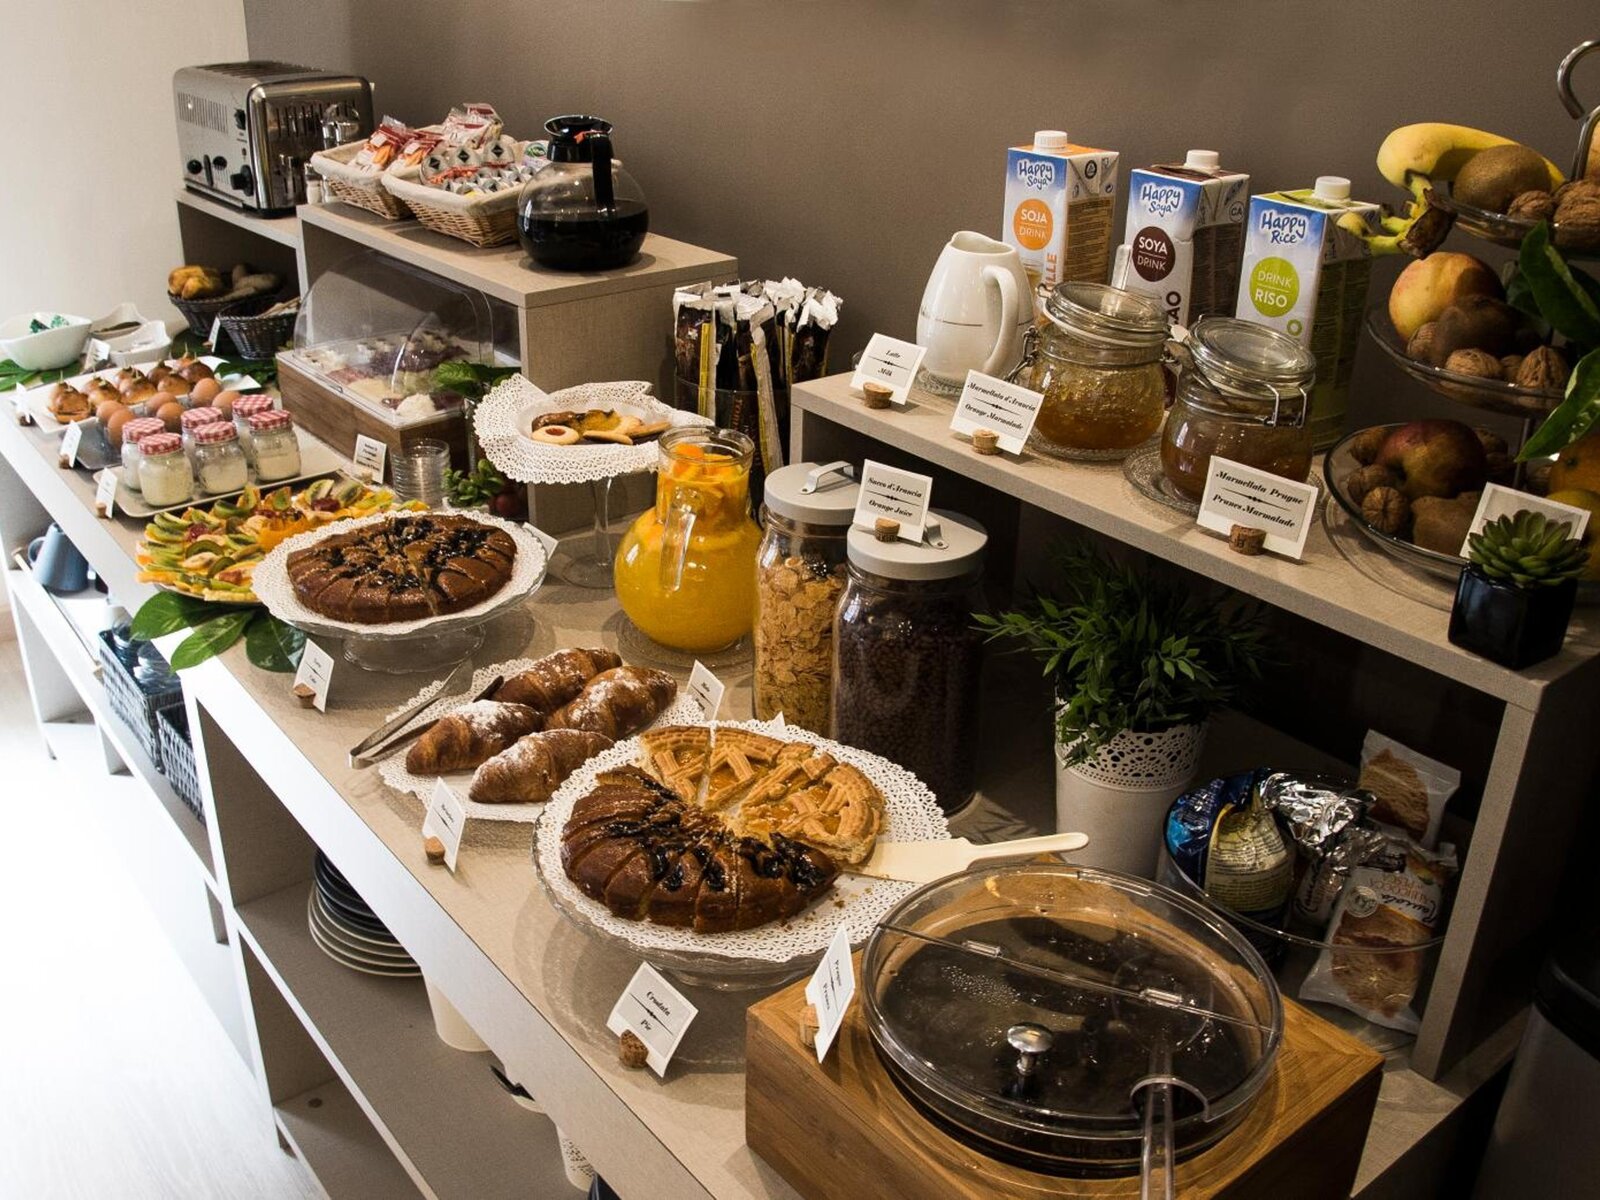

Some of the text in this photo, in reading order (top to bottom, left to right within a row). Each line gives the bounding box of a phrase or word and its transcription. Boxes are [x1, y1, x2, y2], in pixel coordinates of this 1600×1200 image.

[1019, 161, 1053, 182] Happy
[1027, 175, 1048, 190] Soya
[1142, 185, 1181, 208] Happy
[1021, 209, 1048, 225] SOJA
[1149, 202, 1172, 217] Soya
[1019, 226, 1048, 240] DRINK
[1261, 212, 1306, 239] Happy
[1138, 236, 1168, 255] SOYA
[1271, 230, 1297, 244] Rice
[1137, 255, 1167, 272] DRINK
[1258, 271, 1292, 289] DRINK
[1255, 289, 1288, 308] RISO
[877, 367, 893, 377] Milk
[967, 382, 1037, 412] Marmellata d'Arancia
[964, 403, 1024, 430] Orange Marmalade
[867, 477, 923, 498] Succo d'Arancia
[1215, 470, 1304, 505] Marmellata Prugne
[868, 499, 913, 517] Orange Juice
[1212, 493, 1296, 528] Prunes Marmalade
[640, 1019, 652, 1031] Pie
